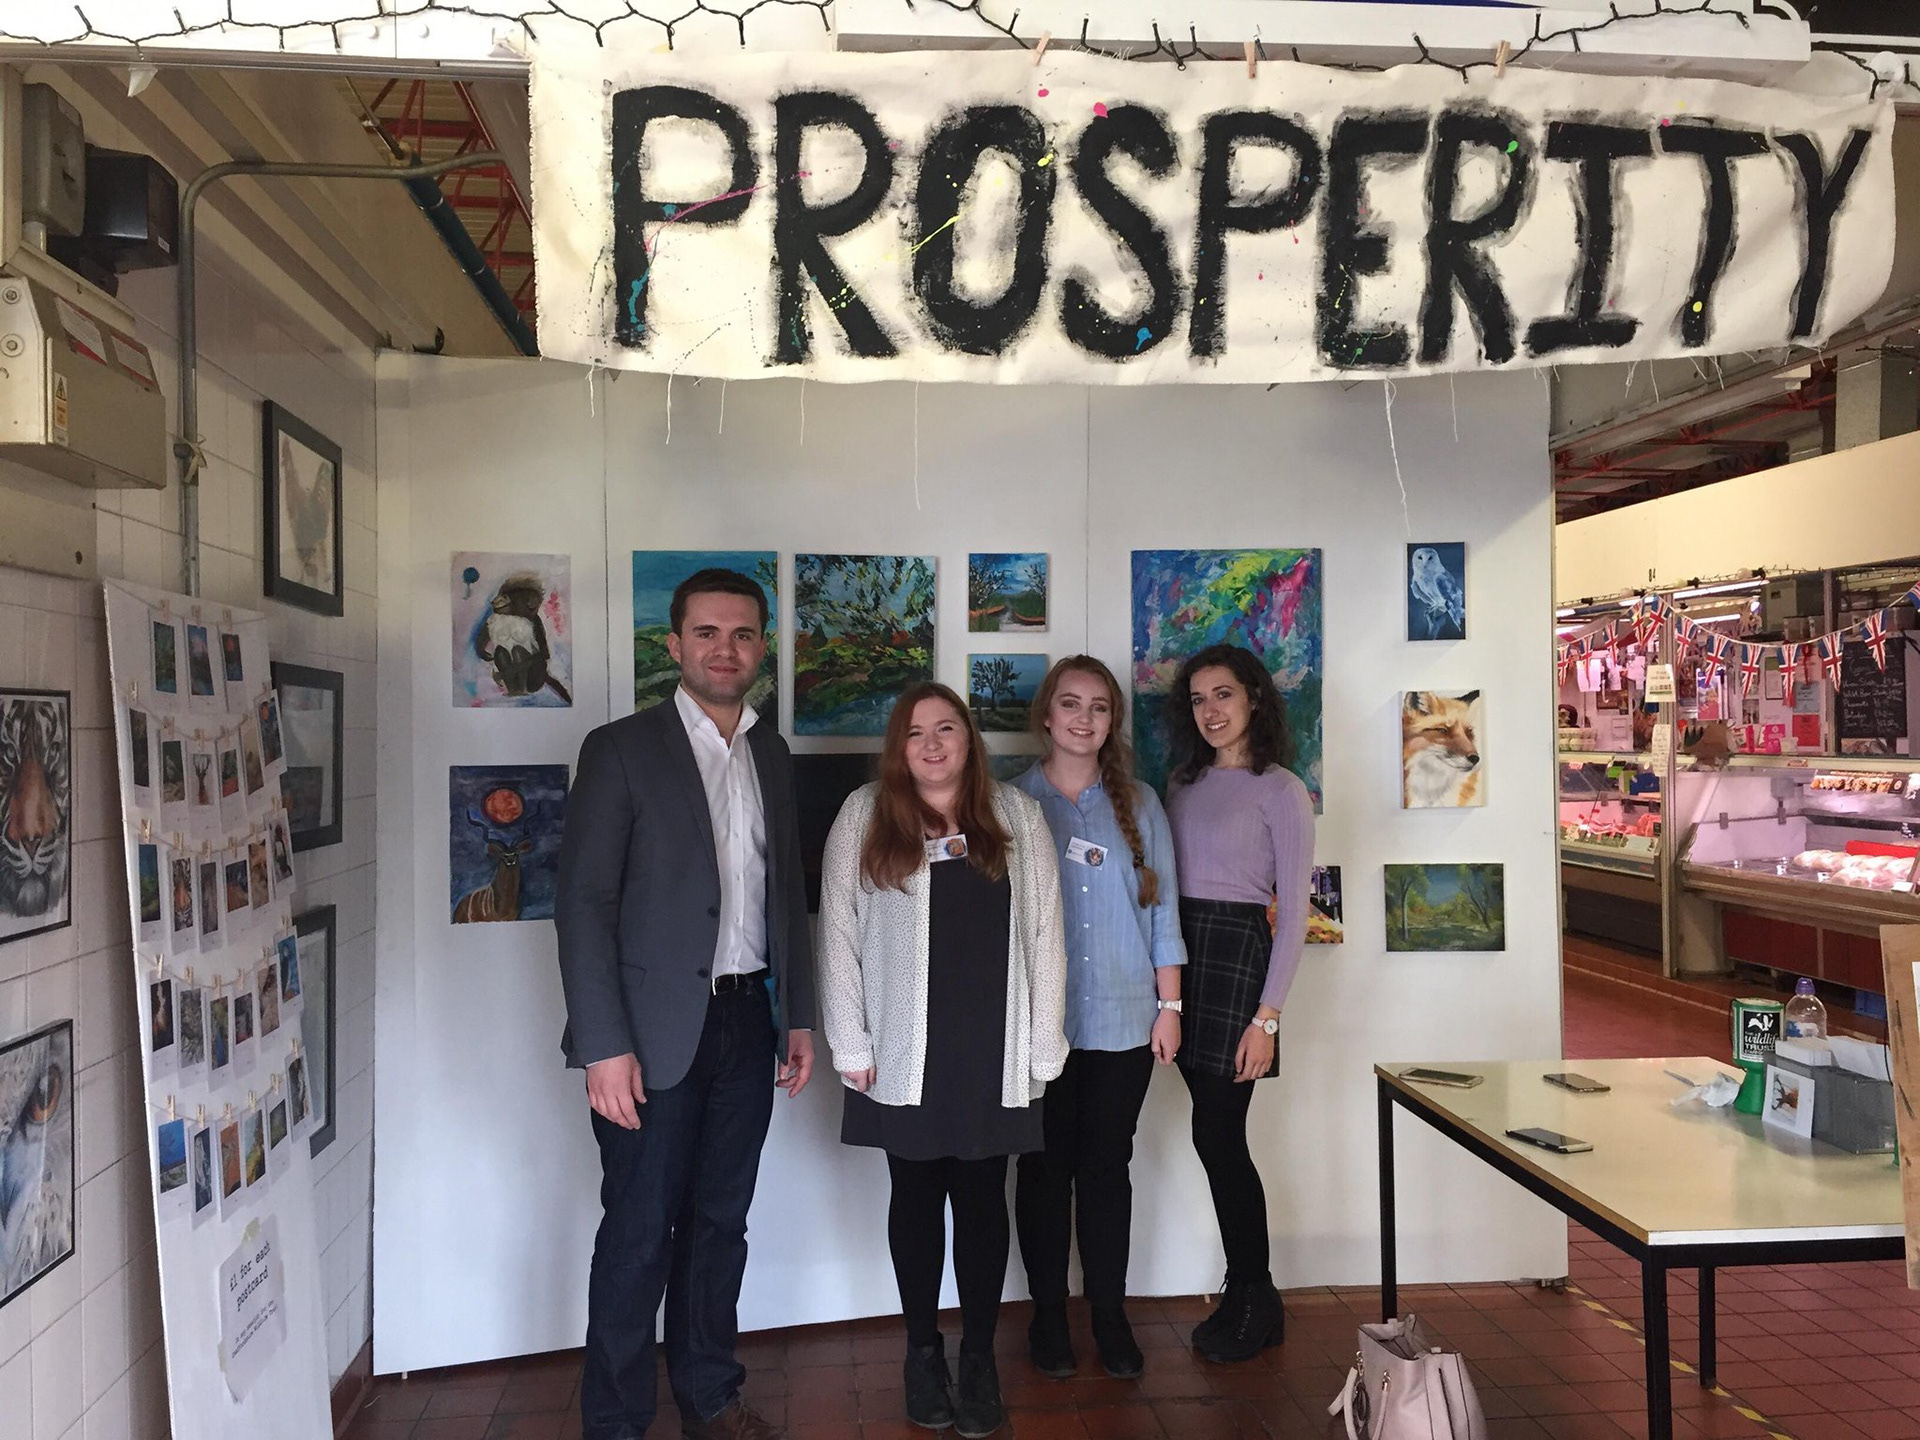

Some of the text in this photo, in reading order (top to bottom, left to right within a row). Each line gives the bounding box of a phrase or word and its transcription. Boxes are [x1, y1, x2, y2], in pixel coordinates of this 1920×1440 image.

[611, 86, 1872, 366] PROSPERITY
[240, 1260, 252, 1279] for
[255, 1240, 271, 1263] each
[237, 1265, 268, 1312] postcard
